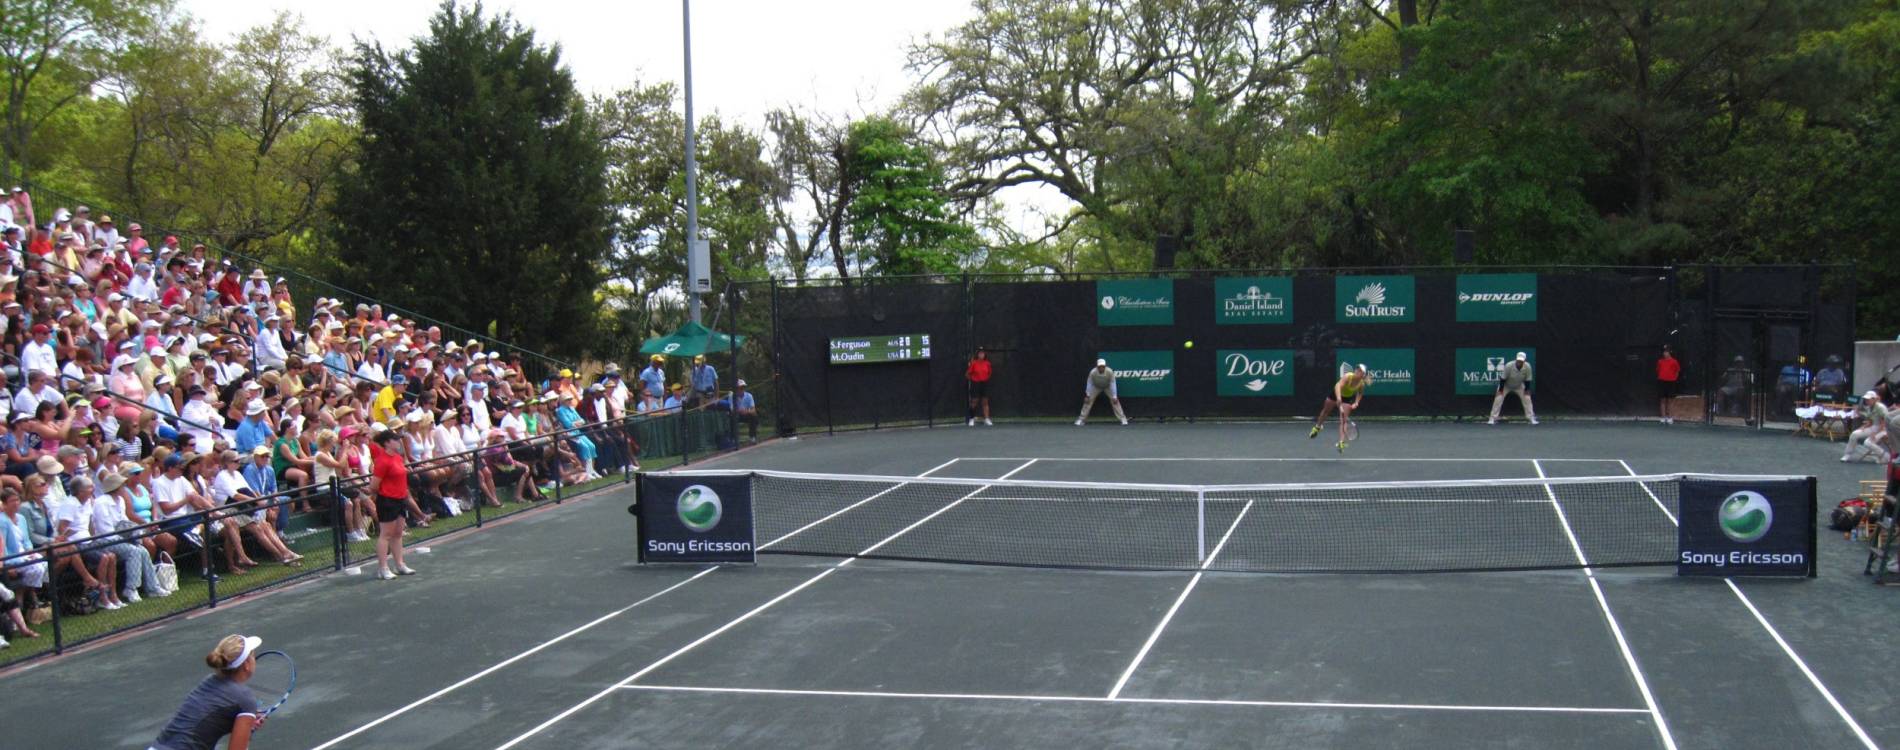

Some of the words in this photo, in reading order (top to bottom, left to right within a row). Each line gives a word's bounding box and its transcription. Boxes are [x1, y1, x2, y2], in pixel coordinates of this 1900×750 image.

[1471, 293, 1533, 301] DUNLOP
[1225, 299, 1255, 310] Daniel
[1257, 299, 1283, 310] Island
[830, 340, 871, 350] S.Ferguson
[831, 352, 865, 361] M.Oudin
[1225, 353, 1285, 376] Dove
[1113, 369, 1171, 378] DUNLOP
[1383, 370, 1411, 379] Health
[648, 540, 685, 554] Sony
[688, 540, 751, 552] Ericsson
[1681, 551, 1725, 567] Sony
[1729, 551, 1803, 564] Ericsson
